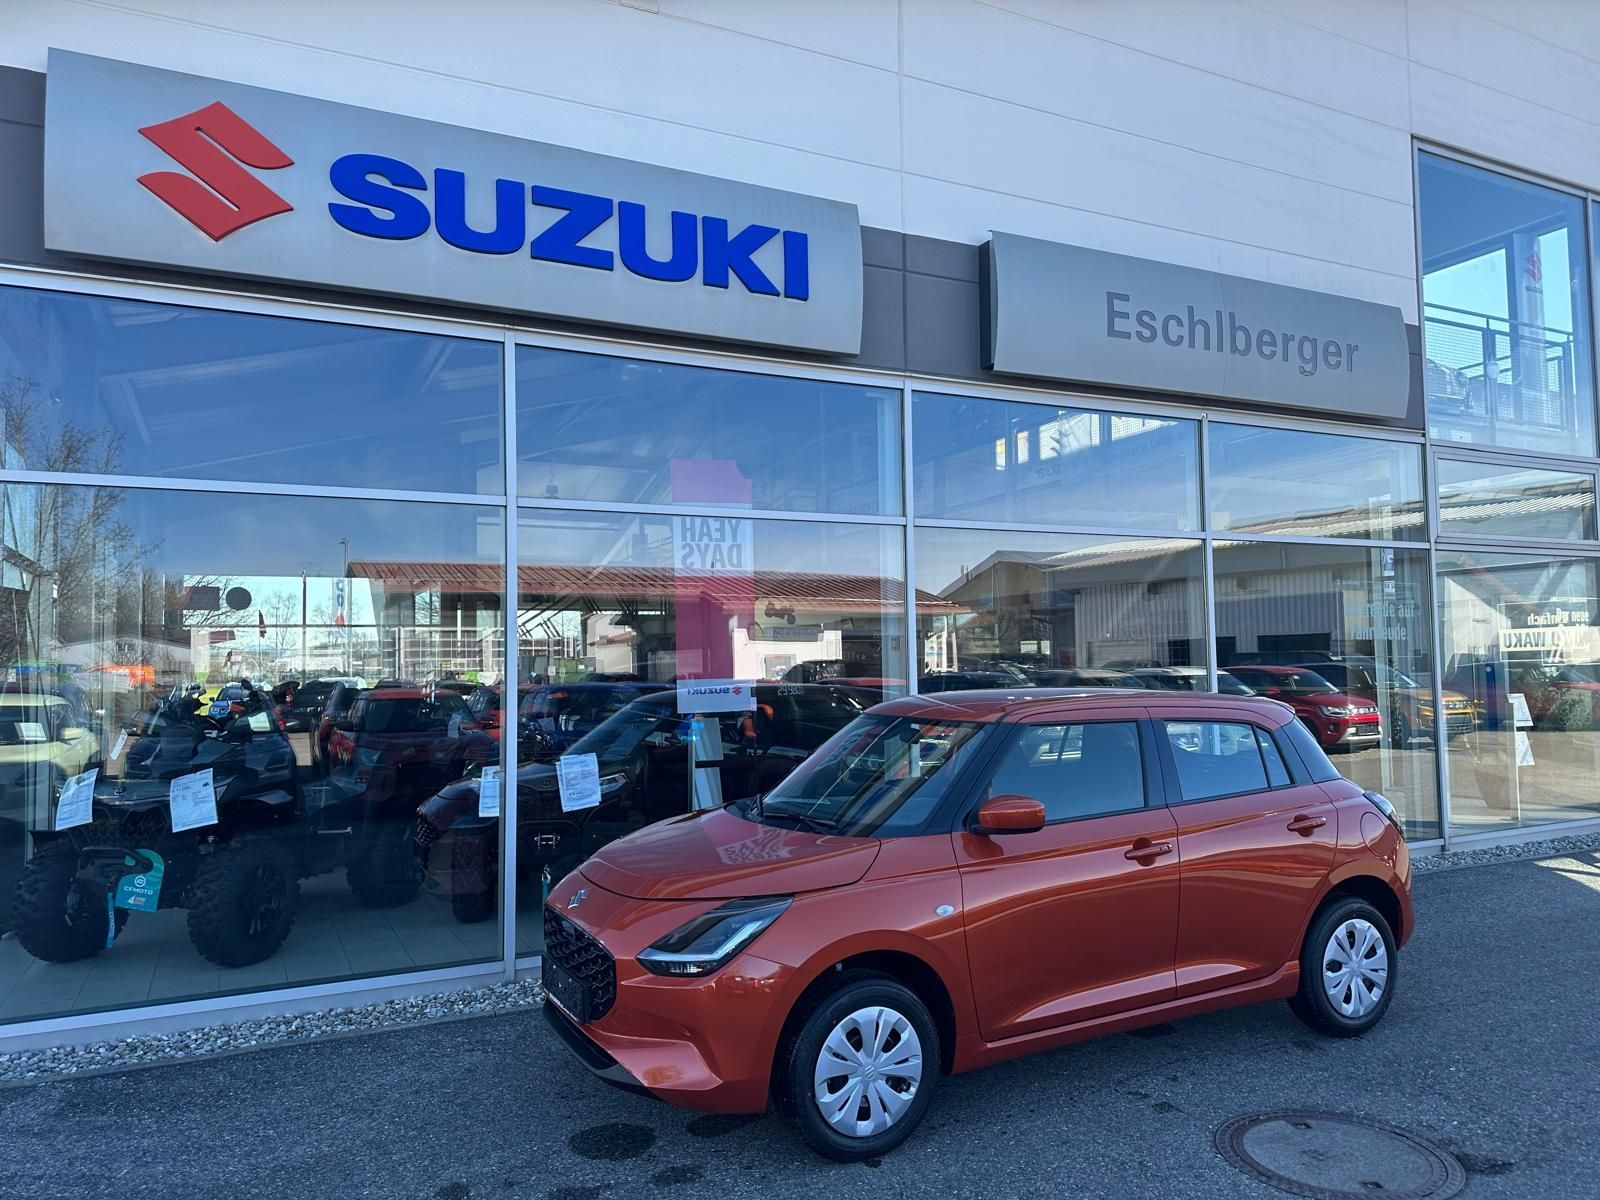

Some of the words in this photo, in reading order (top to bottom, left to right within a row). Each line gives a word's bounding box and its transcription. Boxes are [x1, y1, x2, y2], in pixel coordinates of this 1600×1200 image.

[328, 153, 809, 301] SUZUKI
[1106, 291, 1359, 377] Eschlberger
[124, 886, 153, 896] CFMOTO
